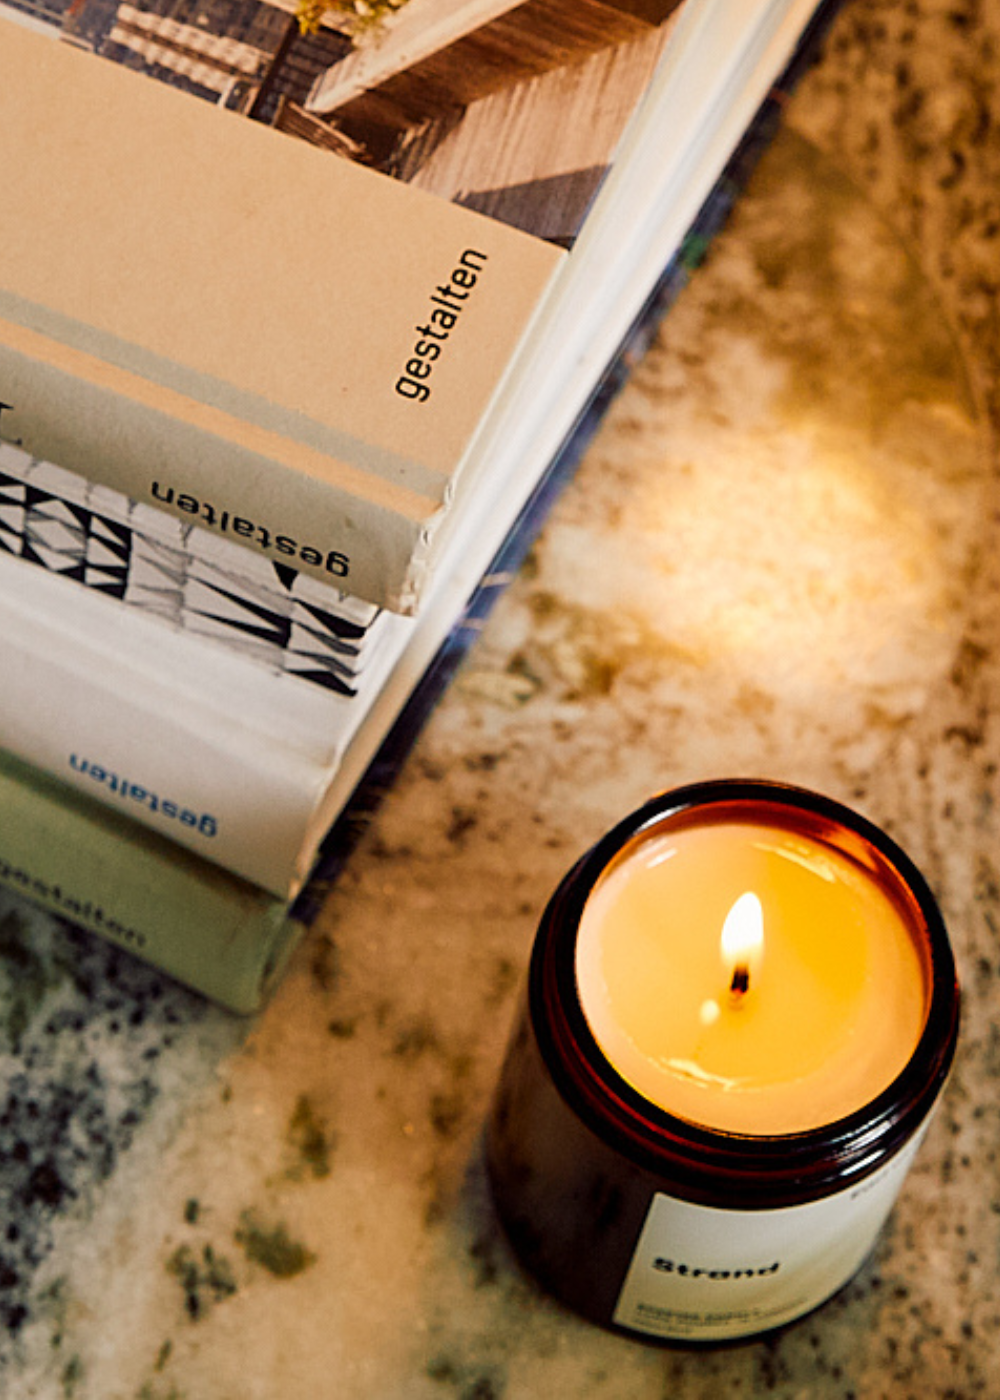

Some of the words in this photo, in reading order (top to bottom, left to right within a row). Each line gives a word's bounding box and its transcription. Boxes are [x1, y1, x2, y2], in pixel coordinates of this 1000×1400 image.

[394, 247, 489, 404] gestalten
[150, 481, 350, 579] gestalten
[70, 753, 219, 839] gestalten
[652, 1256, 781, 1280] Strand
